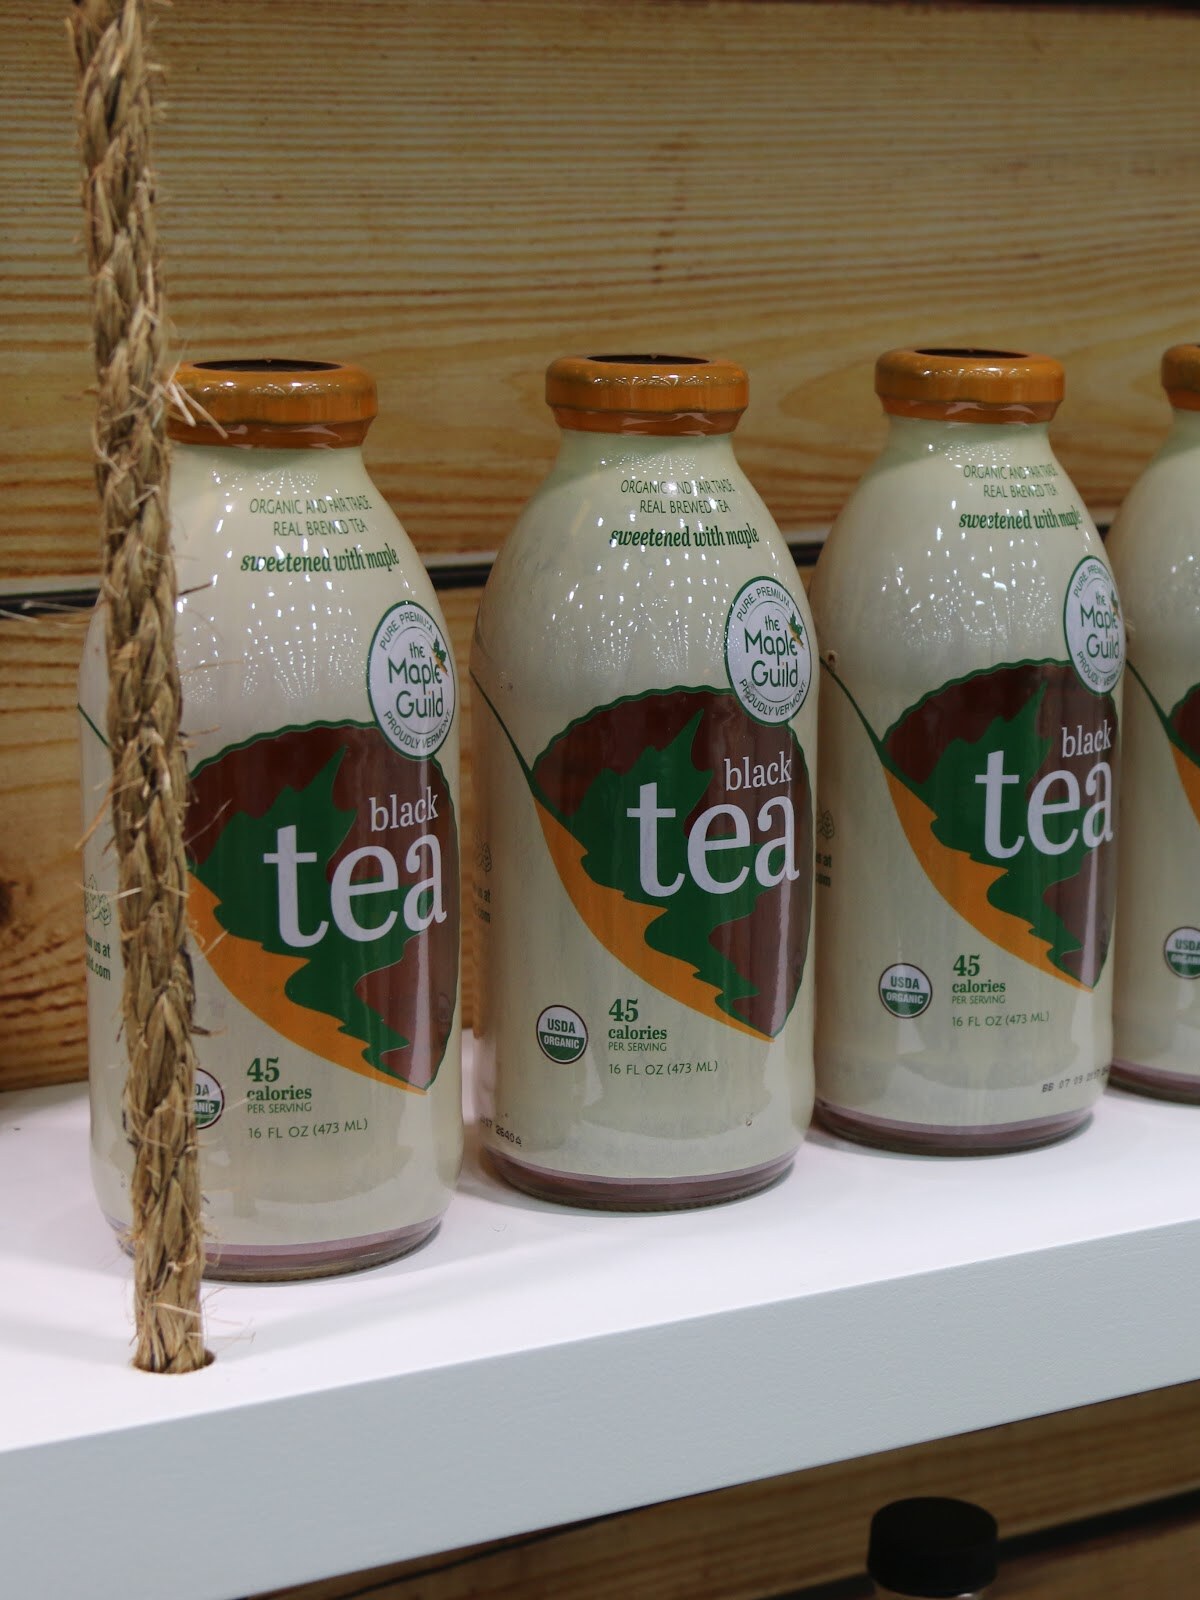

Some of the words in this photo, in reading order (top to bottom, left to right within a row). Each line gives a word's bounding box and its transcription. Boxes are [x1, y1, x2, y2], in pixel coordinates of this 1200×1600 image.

[963, 465, 1007, 480] ORGANIC
[620, 480, 667, 494] ORGANIC
[667, 480, 692, 494] ND
[983, 485, 1008, 498] REAL
[1010, 484, 1045, 498] BREWED
[249, 499, 302, 514] ORGANIC
[306, 499, 328, 514] AND
[329, 498, 350, 512] FAIR
[640, 500, 666, 514] REAL
[670, 500, 711, 514] BREWED
[273, 521, 304, 536] REAL
[348, 518, 368, 533] TEA
[959, 509, 1032, 529] sweetened
[1033, 508, 1059, 529] with
[610, 525, 691, 547] sweetened
[693, 525, 725, 547] with
[725, 522, 759, 549] maple
[240, 550, 331, 572] sweetened
[333, 546, 366, 571] with
[367, 543, 400, 573] maple
[765, 615, 780, 631] the
[1080, 603, 1119, 639] Maple
[409, 642, 426, 658] the
[744, 627, 798, 665] Maple
[1086, 632, 1120, 659] Guild
[388, 657, 442, 694] Maple
[751, 659, 798, 688] Guild
[396, 687, 443, 718] Guild
[740, 678, 774, 716] PROUDLY
[384, 711, 420, 749] PROUDLY
[1062, 720, 1112, 758] black
[724, 751, 792, 792] black
[369, 786, 438, 832] black
[974, 750, 1113, 859] tea
[626, 782, 799, 898] tea
[263, 824, 447, 948] tea
[953, 954, 980, 977] 45
[890, 975, 920, 990] USDA
[952, 979, 1006, 993] calories
[886, 992, 924, 1005] ORGANIC
[952, 995, 967, 1005] PER
[970, 995, 1006, 1004] SERVING
[608, 998, 639, 1022] 45
[952, 1016, 963, 1027] 16
[968, 1017, 980, 1027] FL
[985, 1016, 1002, 1027] OZ
[1005, 1013, 1027, 1026] (473
[1031, 1011, 1050, 1023] ML)
[547, 1018, 576, 1034] USDA
[608, 1025, 667, 1040] calories
[543, 1034, 580, 1050] ORGANIC
[608, 1042, 625, 1051] PER
[628, 1042, 667, 1052] SERVING
[247, 1057, 280, 1083] 45
[609, 1063, 621, 1075] 16
[626, 1064, 640, 1076] FL
[645, 1064, 664, 1076] OZ
[667, 1062, 692, 1076] (473
[695, 1060, 718, 1073] ML)
[246, 1084, 312, 1101] calories
[247, 1104, 266, 1114] PER
[269, 1102, 312, 1114] SERVING
[248, 1128, 261, 1140] 16
[268, 1128, 284, 1139] FL
[288, 1126, 309, 1138] OZ
[313, 1122, 340, 1138] (473
[344, 1118, 368, 1133] ML)
